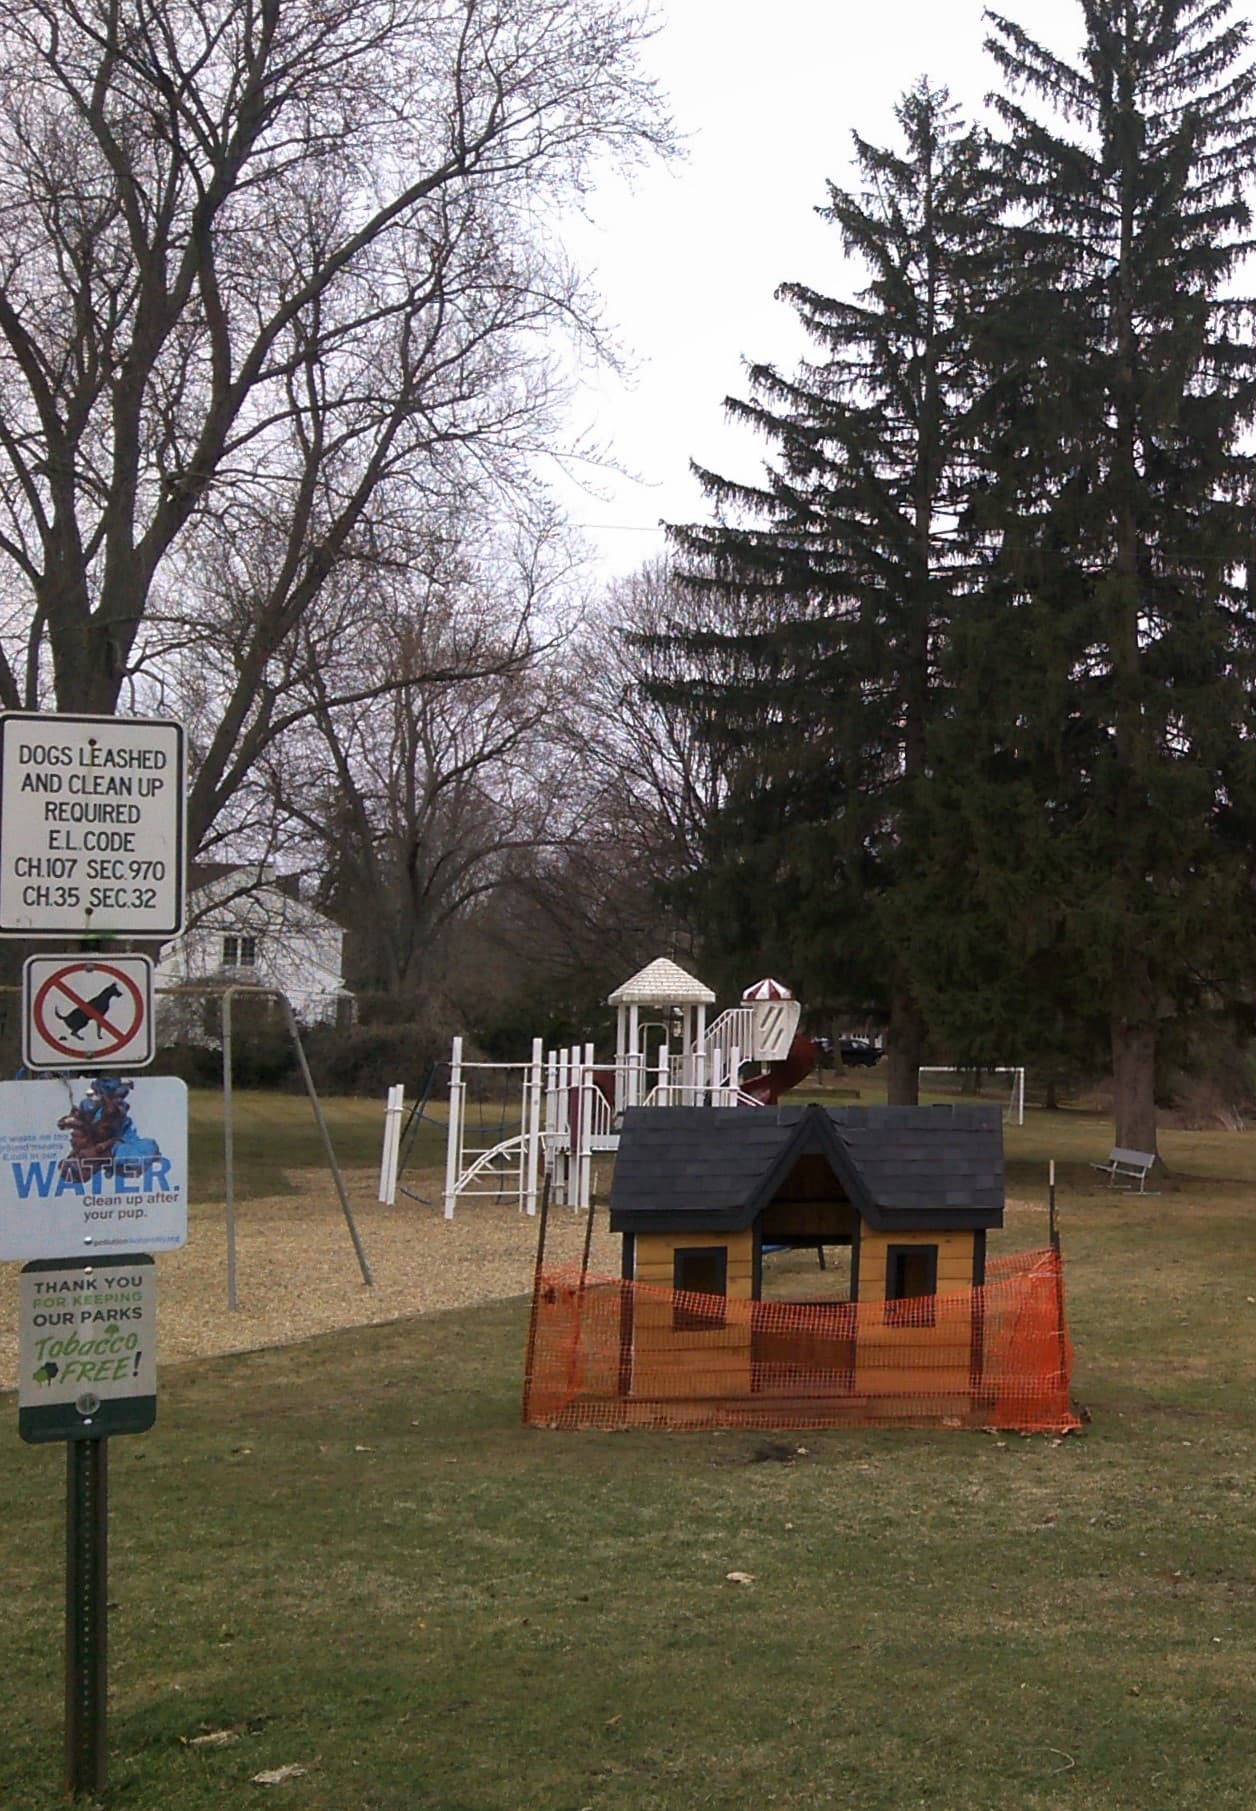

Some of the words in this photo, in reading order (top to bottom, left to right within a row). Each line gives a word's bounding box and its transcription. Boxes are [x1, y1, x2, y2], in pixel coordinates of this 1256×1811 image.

[19, 745, 73, 766] DOGS
[79, 747, 167, 769] LEASHED
[21, 773, 62, 793] AND
[68, 774, 132, 796] CLEAN
[138, 778, 164, 797] UP
[44, 801, 141, 824] REQUIRED
[14, 857, 78, 878] CH.107
[86, 859, 165, 881] SEC.970
[23, 886, 80, 907] CH.35
[89, 887, 157, 909] SEC.32
[12, 1155, 180, 1199] WATER.
[83, 1195, 122, 1207] Clean
[126, 1195, 143, 1206] up
[147, 1192, 179, 1204] after
[84, 1210, 113, 1223] your
[118, 1209, 148, 1220] pup.
[34, 1279, 97, 1294] THANK
[104, 1276, 143, 1289] YOU
[33, 1296, 66, 1309] FOR
[73, 1291, 143, 1307] KEEPING
[33, 1312, 74, 1327] OUR
[81, 1307, 143, 1324] PARKS
[34, 1331, 138, 1361] Tobacco
[59, 1351, 142, 1385] FREE!
